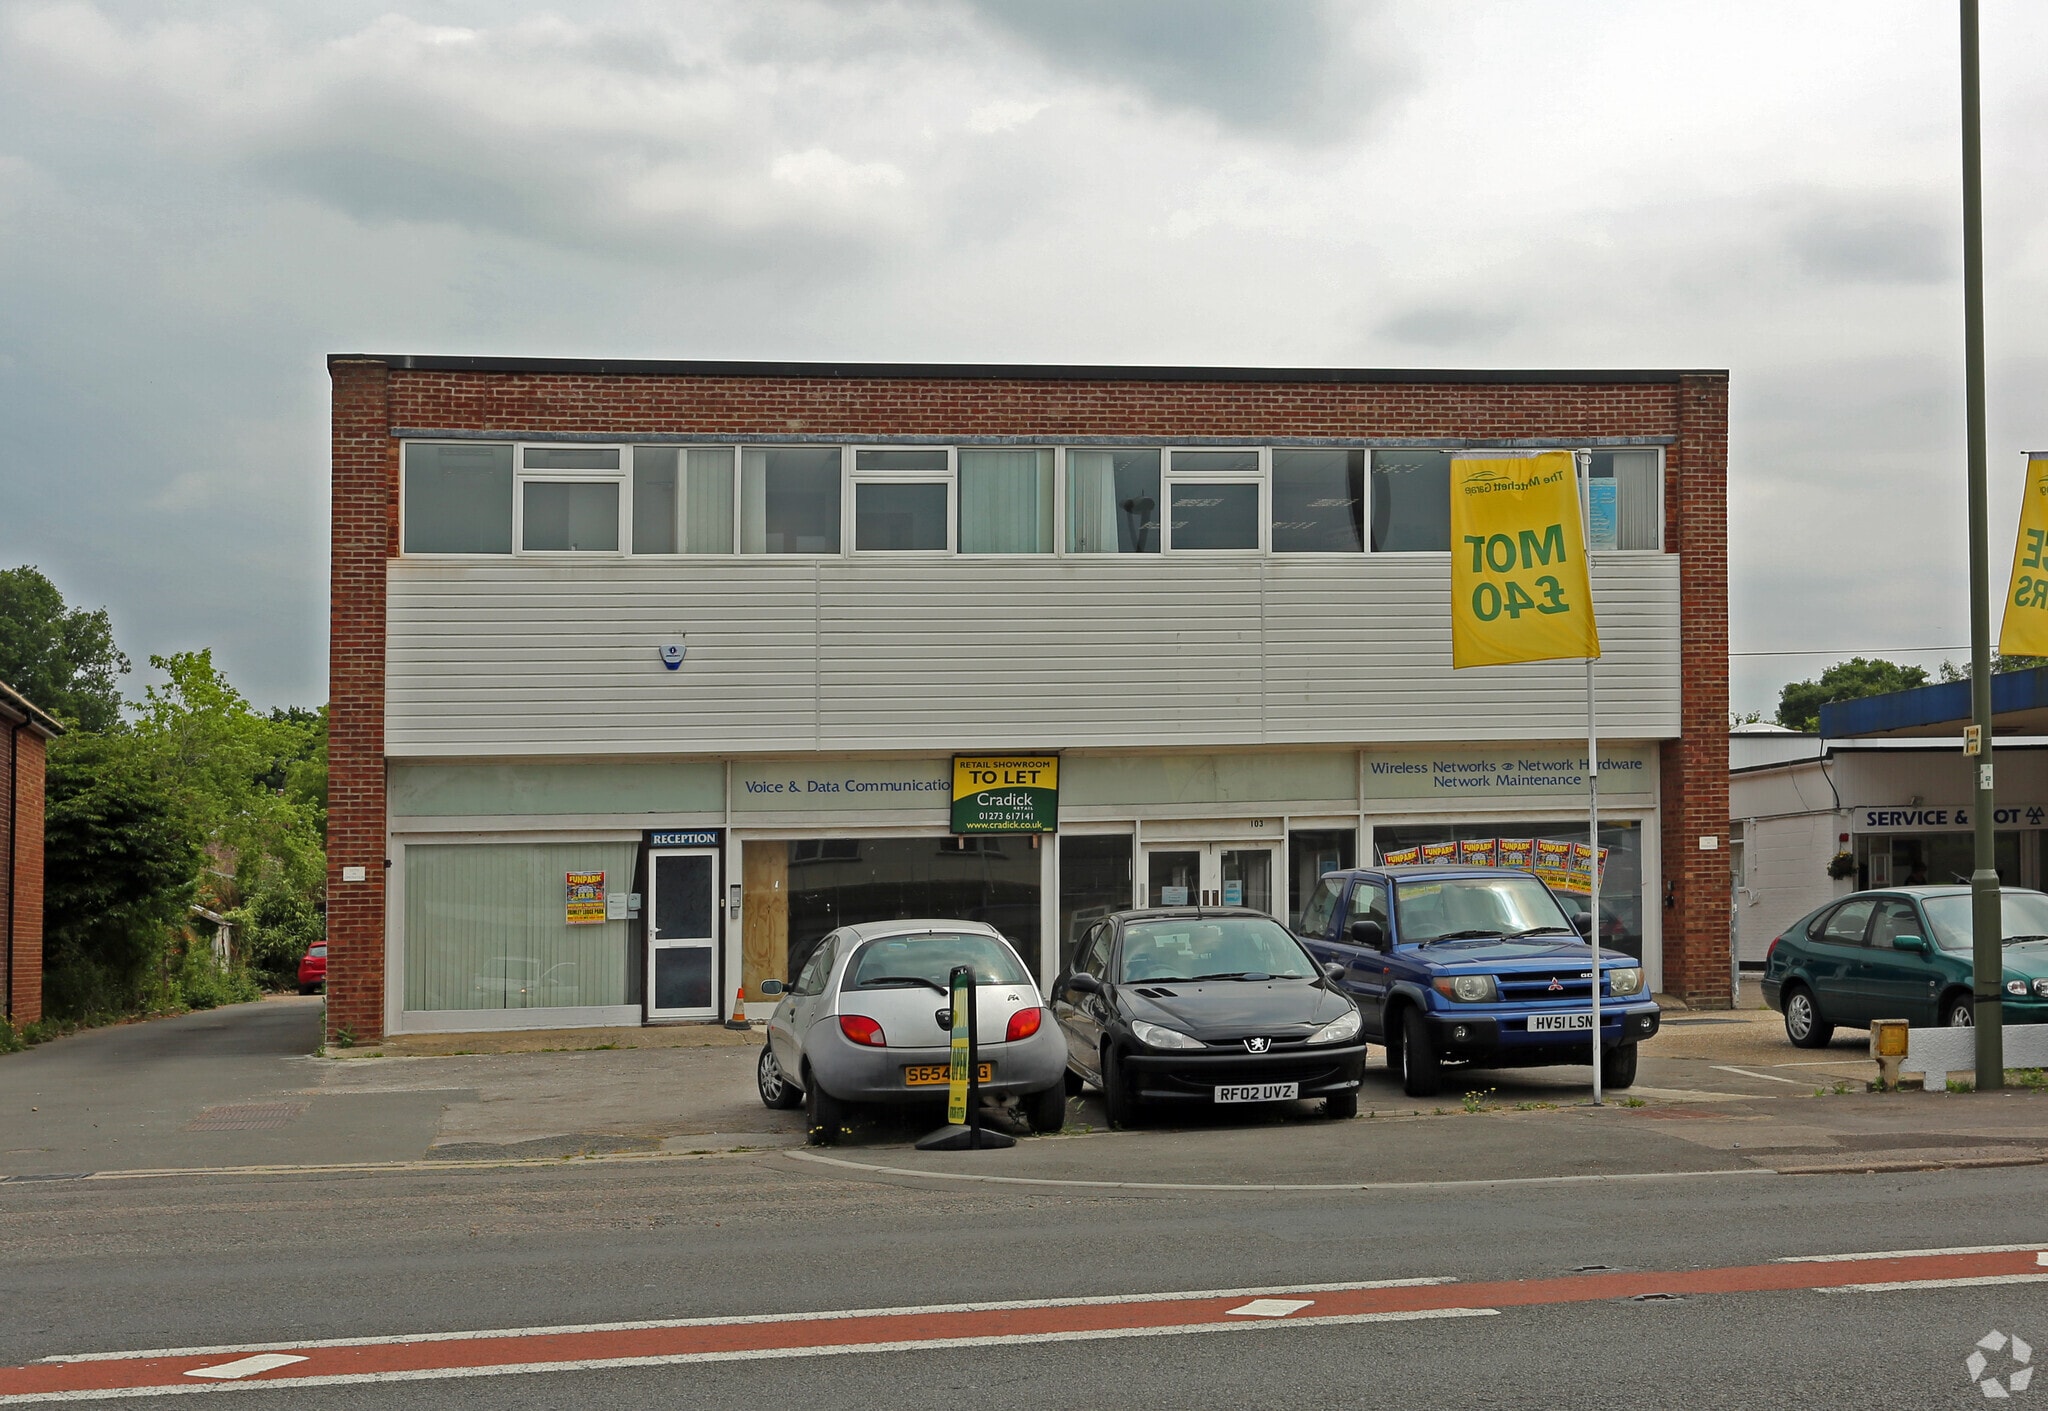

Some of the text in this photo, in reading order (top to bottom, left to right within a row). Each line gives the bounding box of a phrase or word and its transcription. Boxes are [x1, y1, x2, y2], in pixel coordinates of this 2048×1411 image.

[1371, 758, 1643, 774] Wireless Networks Network Hrdware
[969, 770, 1041, 784] TO LET
[1434, 774, 1581, 787] Network Maintenance
[746, 779, 951, 793] Voice & Data Communicatio
[977, 793, 1033, 806] Cradick
[979, 812, 1034, 820] 01273 617141
[1867, 809, 2021, 826] SERVICE & OT
[966, 820, 1042, 829] www.cradick.co.uk
[1250, 819, 1264, 828] 103
[653, 833, 716, 845] RECEPTION
[1425, 846, 1454, 856] FUNPARK
[1463, 842, 1492, 851] FUNPARK
[1502, 842, 1530, 851] FUNPARK
[1540, 843, 1568, 853] FUNPARK
[569, 875, 601, 884] FUNPARK
[1536, 1015, 1593, 1029] HV51 LSN
[1220, 1085, 1292, 1100] RF02 UVZ
